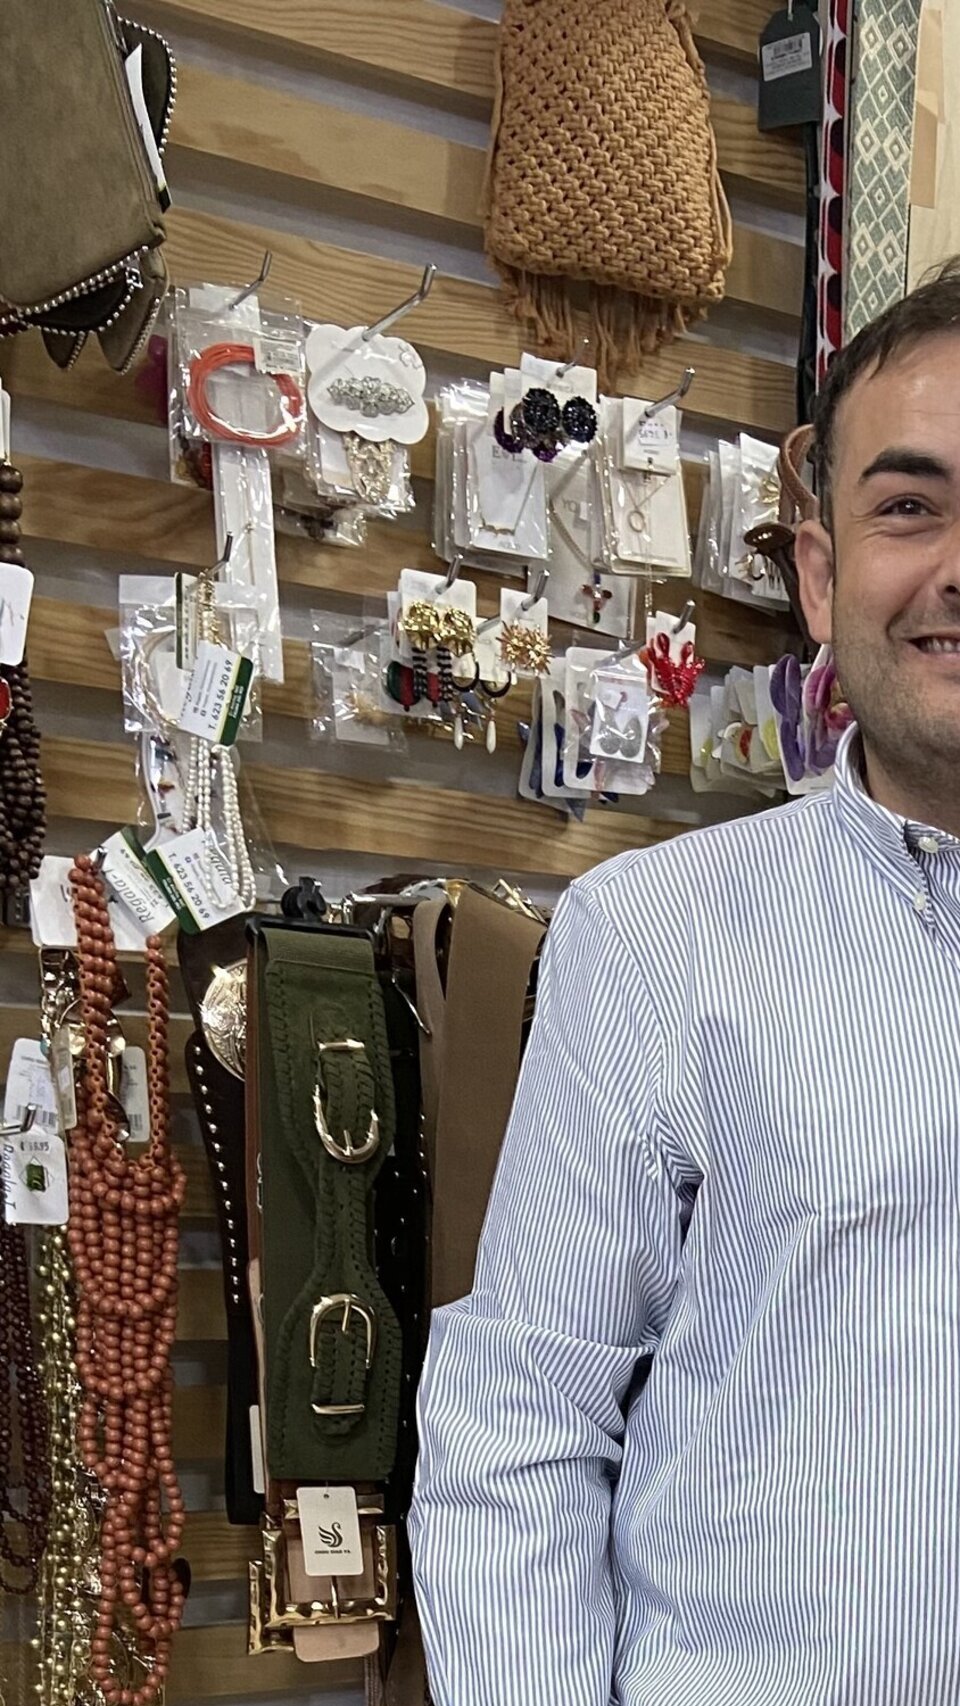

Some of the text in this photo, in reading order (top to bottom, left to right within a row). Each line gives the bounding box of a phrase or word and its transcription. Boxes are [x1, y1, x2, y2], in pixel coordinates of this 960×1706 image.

[224, 659, 233, 672] 69
[220, 674, 230, 688] 20
[217, 689, 226, 702] 56
[212, 703, 222, 721] 623
[173, 863, 188, 880] 623
[184, 880, 193, 894] 56
[191, 893, 202, 907] 20
[199, 906, 211, 919] 69
